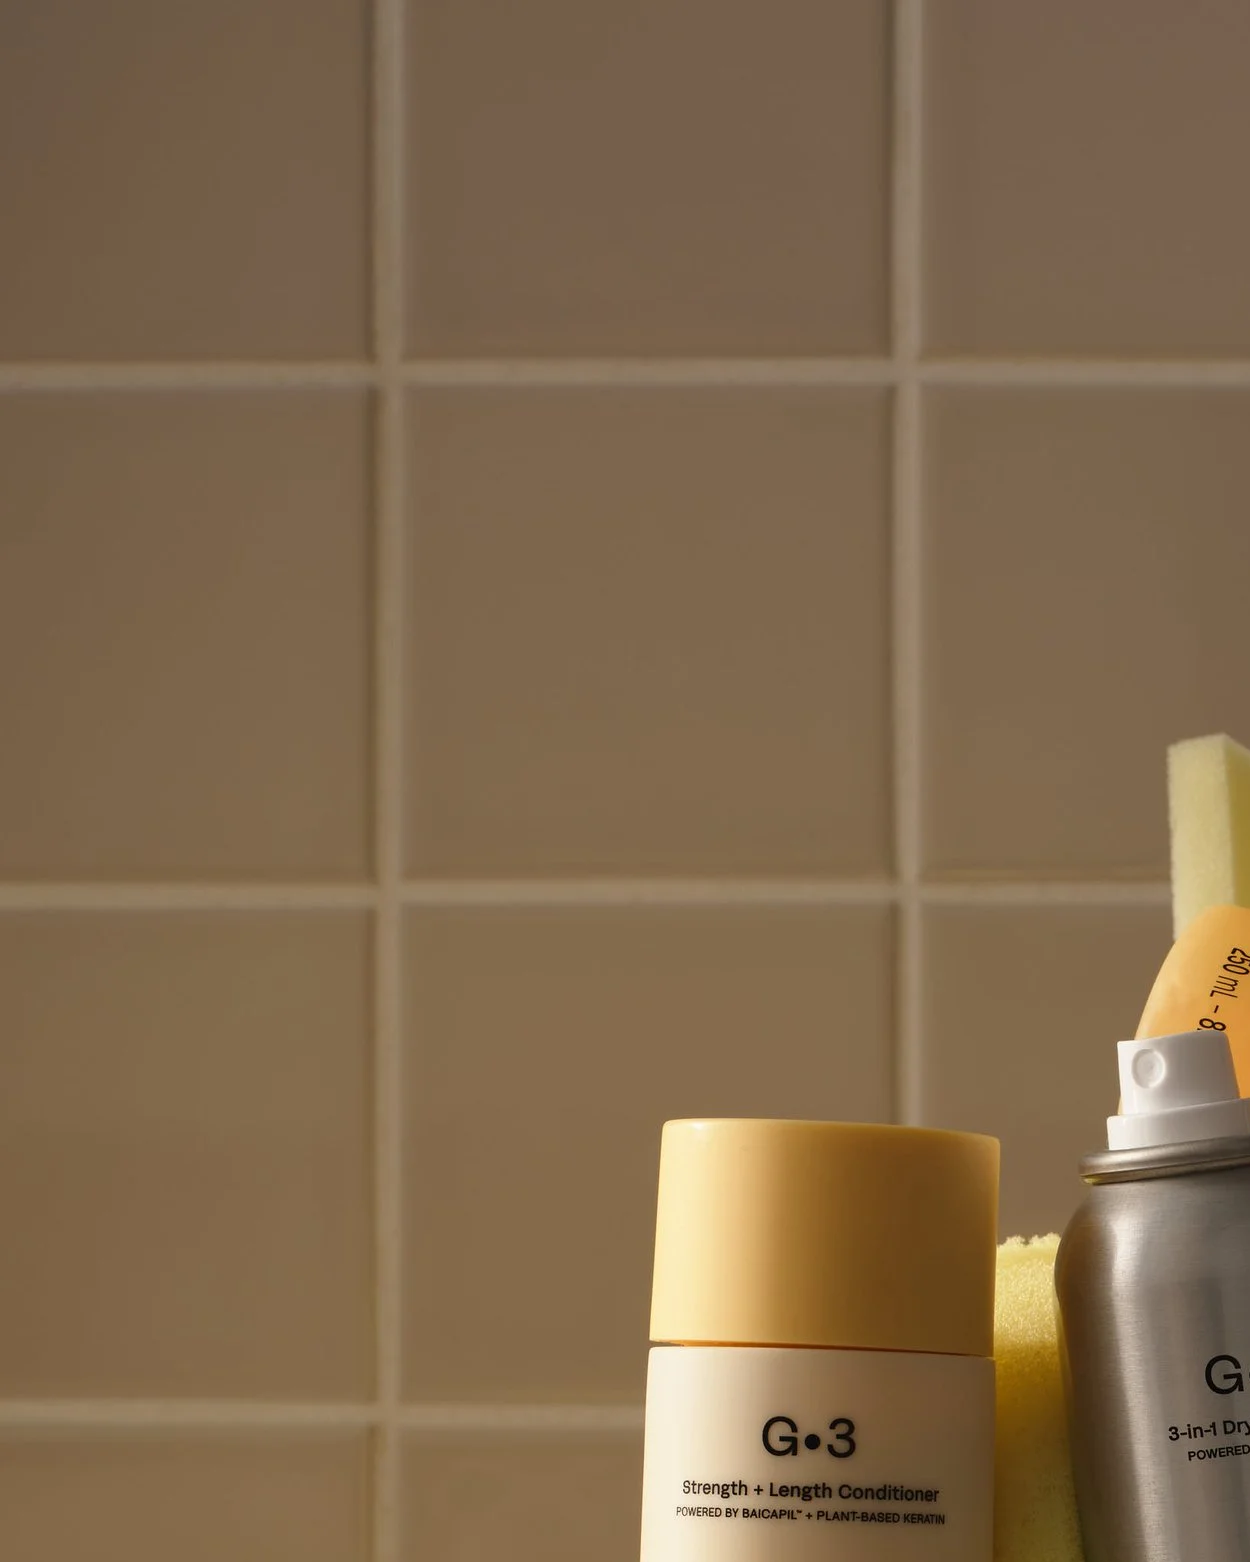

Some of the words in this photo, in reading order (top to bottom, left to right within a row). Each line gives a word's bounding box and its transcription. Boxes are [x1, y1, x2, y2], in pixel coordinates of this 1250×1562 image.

[1208, 975, 1240, 1000] mL
[1168, 1421, 1217, 1441] 3-in-1
[1188, 1444, 1250, 1461] POWERED
[682, 1480, 748, 1499] Strength
[769, 1483, 832, 1502] Length
[838, 1484, 940, 1502] Conditioner
[676, 1506, 722, 1518] POWERED
[725, 1508, 739, 1519] BY
[817, 1510, 900, 1524] PLANT-BASED
[903, 1513, 945, 1525] KERATIN
